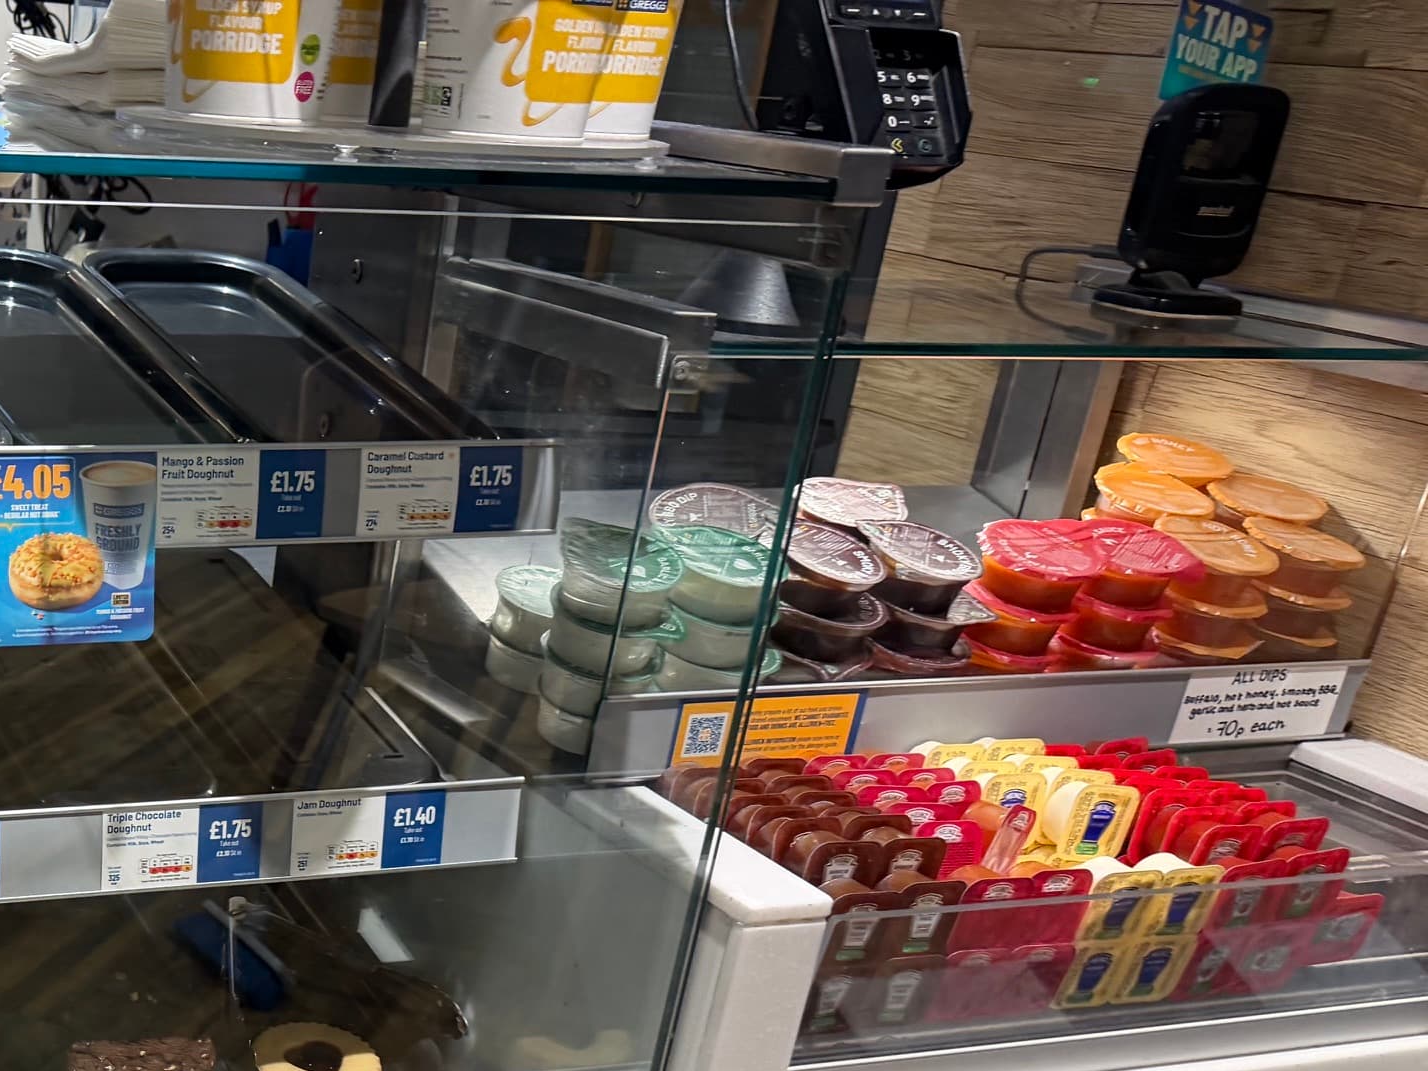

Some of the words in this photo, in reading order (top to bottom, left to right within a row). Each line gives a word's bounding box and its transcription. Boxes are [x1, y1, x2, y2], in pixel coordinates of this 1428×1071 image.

[630, 0, 667, 11] GREGGS
[210, 14, 263, 30] FLAVOUR
[1202, 5, 1248, 49] TAP
[191, 29, 284, 55] PORRIDGE
[1175, 33, 1221, 71] YOUR
[1220, 52, 1257, 82] APP
[877, 71, 886, 83] 5
[906, 72, 916, 83] 6
[882, 93, 893, 104] 8
[911, 94, 920, 105] 9
[162, 456, 194, 468] Mango
[196, 456, 204, 466] &
[206, 456, 244, 466] Passion
[368, 452, 406, 461] Caramel
[408, 451, 444, 460] Custard
[162, 469, 185, 479] Fruit
[187, 468, 234, 480] Doughnut
[367, 464, 412, 475] Doughnut
[270, 471, 315, 493] £1.75
[470, 465, 513, 487] £1.75
[679, 493, 698, 504] DIP
[95, 523, 141, 536] FRESHLY
[96, 536, 140, 551] GROUND
[1232, 672, 1254, 685] ALL
[1259, 669, 1287, 683] DIPS
[1225, 692, 1243, 701] hot
[1218, 704, 1234, 713] and
[1251, 721, 1285, 732] each
[298, 801, 317, 810] Jam
[319, 798, 361, 810] Doughnut
[107, 813, 133, 823] Triple
[136, 810, 182, 821] Chocolate
[393, 805, 436, 827] £1.40
[107, 825, 151, 834] Doughnut
[209, 818, 252, 840] £1.75
[108, 874, 120, 882] 325
